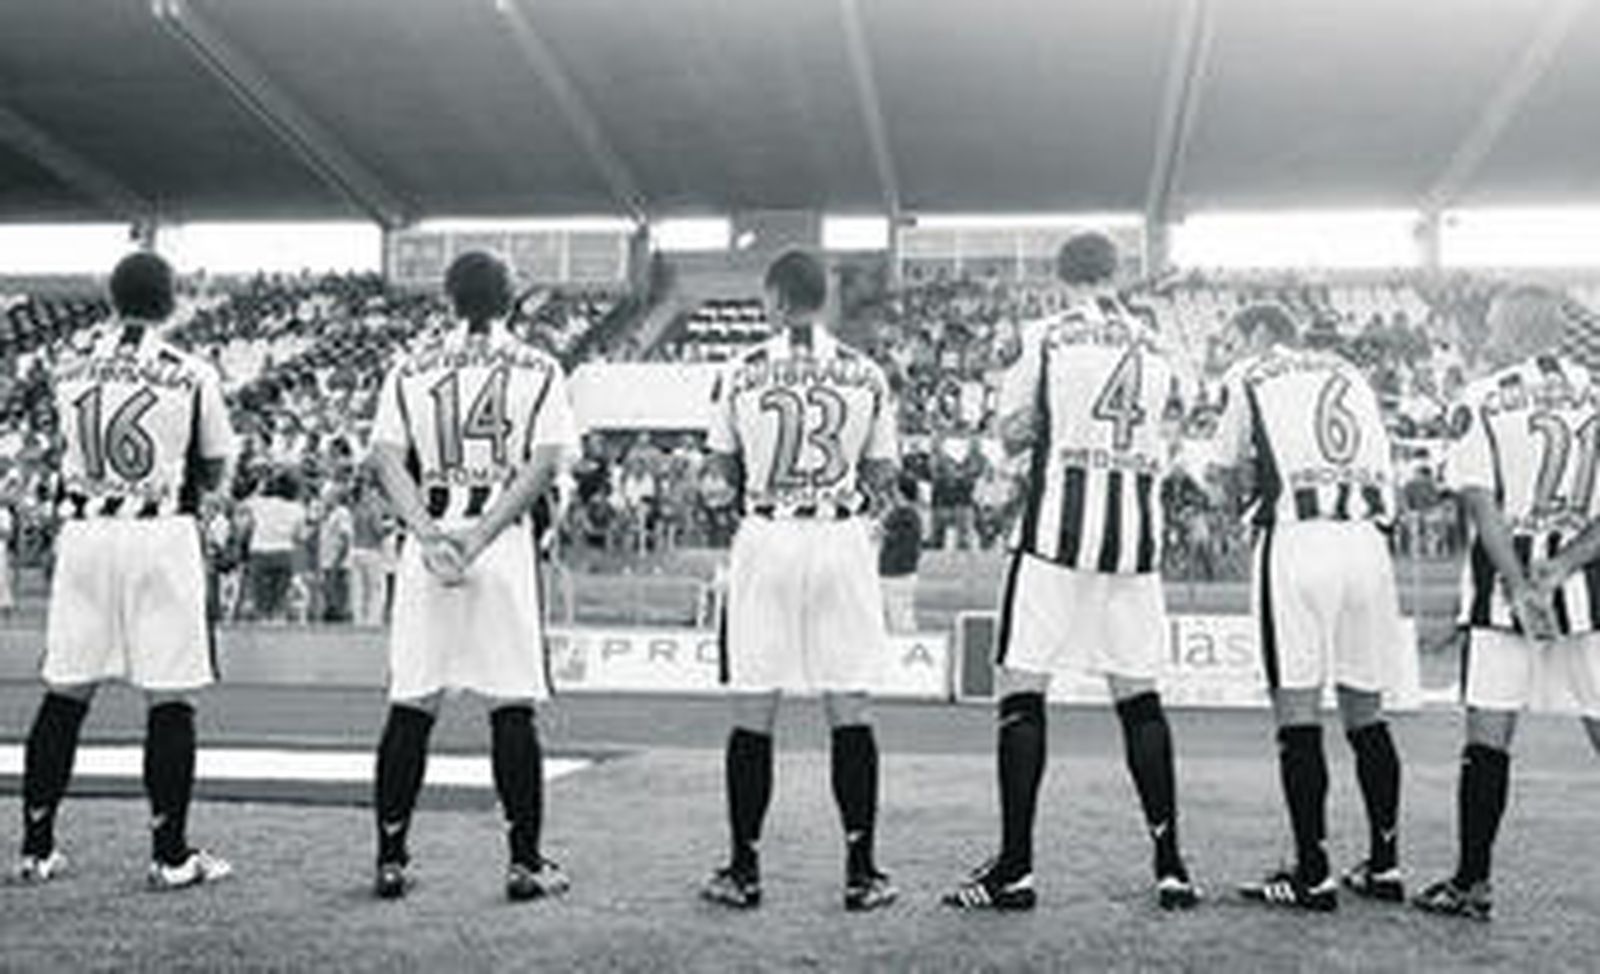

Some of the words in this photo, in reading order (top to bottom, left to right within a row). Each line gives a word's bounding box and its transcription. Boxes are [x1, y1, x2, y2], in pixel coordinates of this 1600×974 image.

[73, 384, 158, 482] 16
[429, 365, 513, 468] 14
[760, 386, 849, 489] 23
[1092, 341, 1146, 450] 4
[1314, 374, 1362, 464] 6
[1528, 411, 1600, 515] 21
